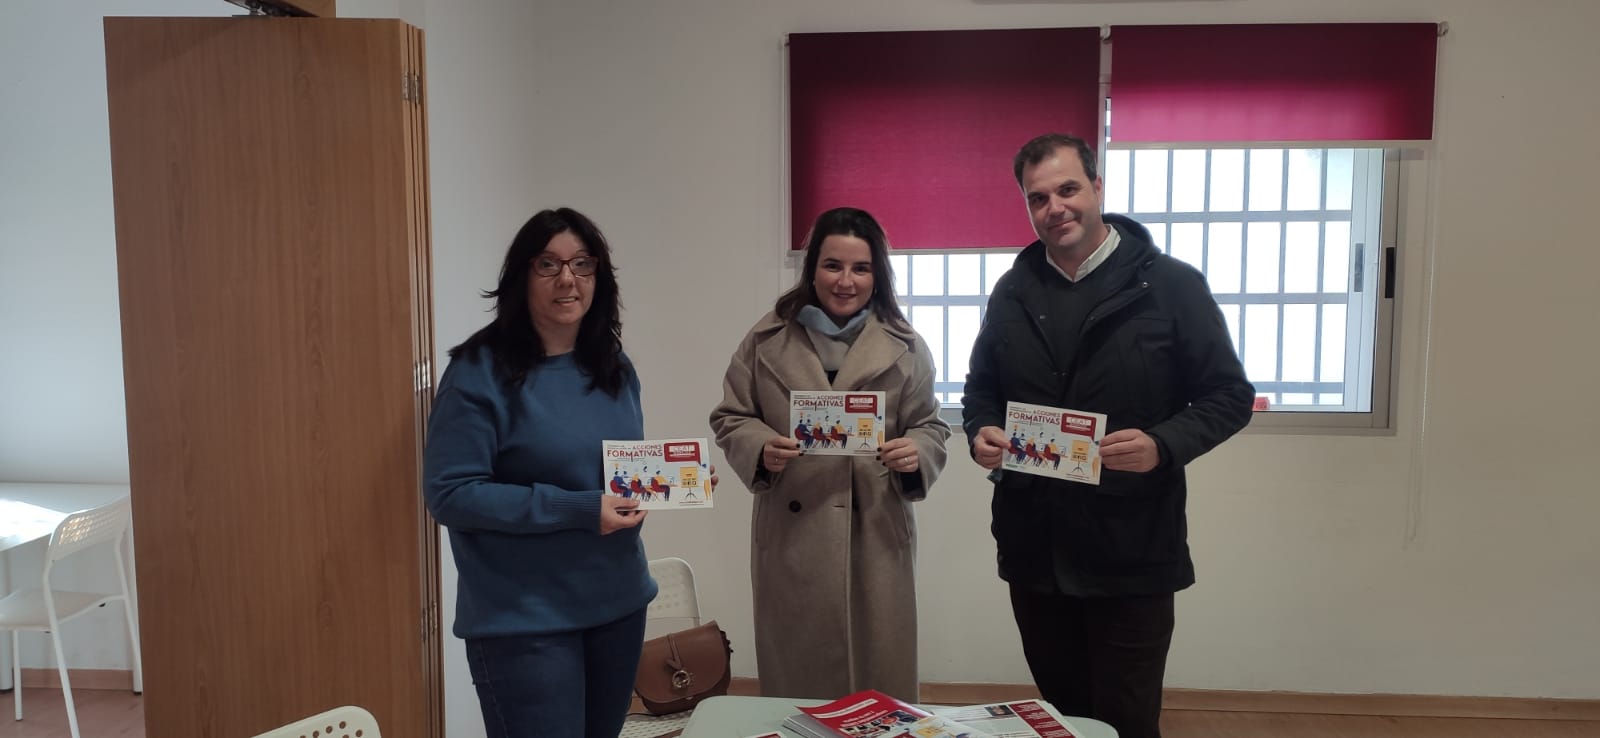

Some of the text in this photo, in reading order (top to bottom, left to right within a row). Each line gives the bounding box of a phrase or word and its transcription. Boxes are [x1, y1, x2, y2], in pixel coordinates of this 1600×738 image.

[794, 400, 844, 409] FORMATIVAS
[1008, 411, 1060, 426] FORMATIVAS
[607, 449, 663, 460] FORMATIVAS
